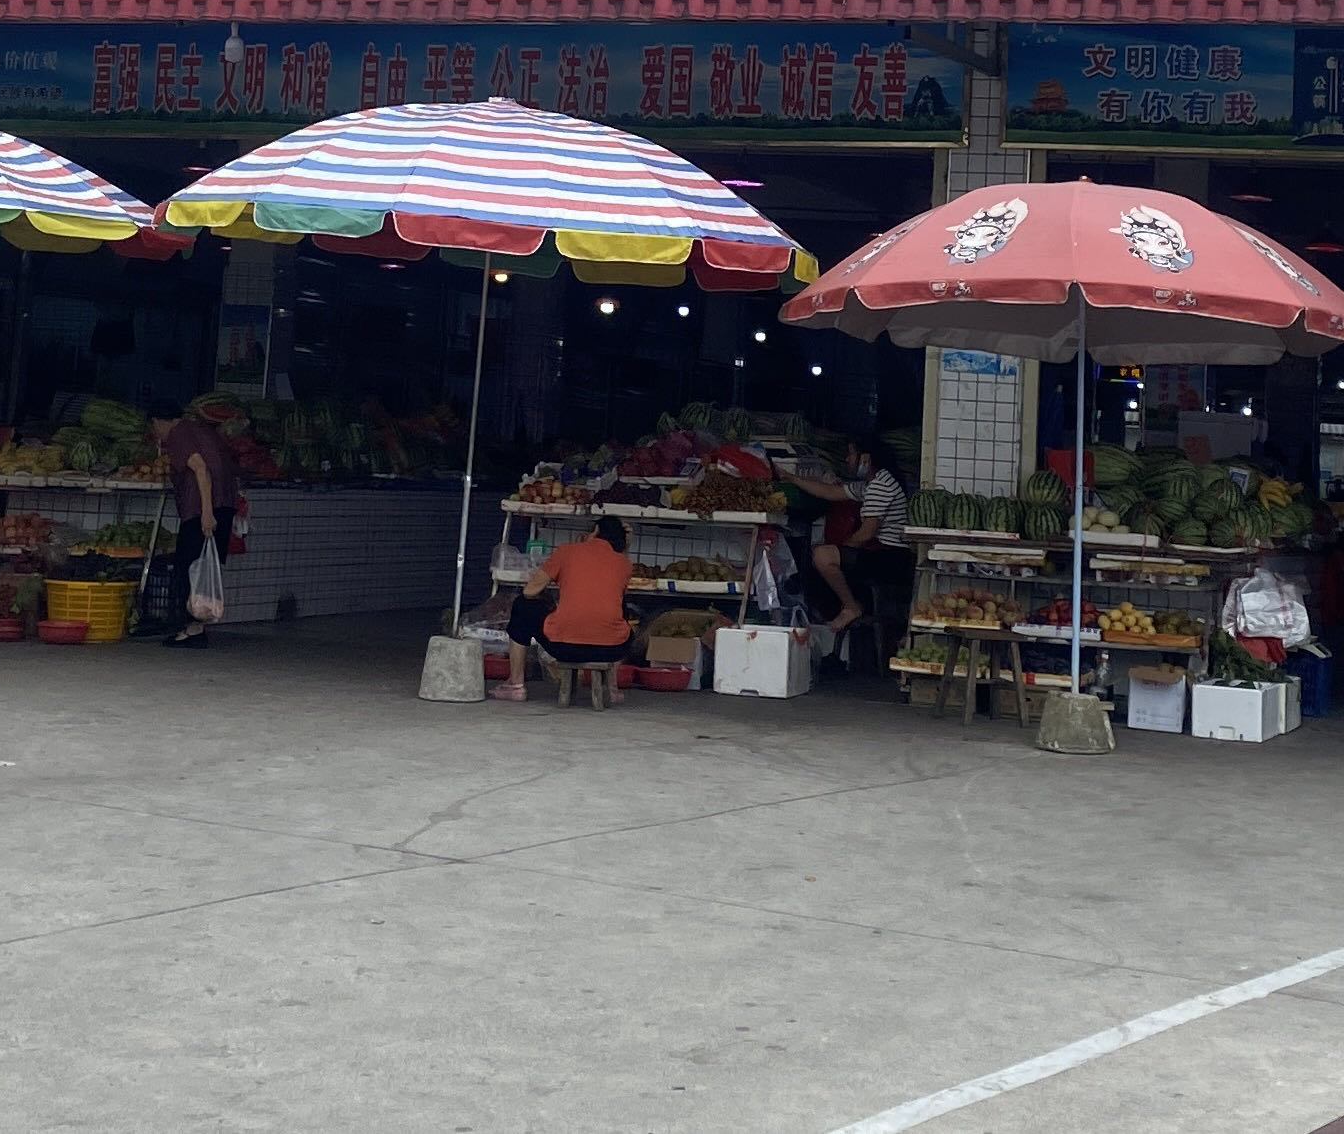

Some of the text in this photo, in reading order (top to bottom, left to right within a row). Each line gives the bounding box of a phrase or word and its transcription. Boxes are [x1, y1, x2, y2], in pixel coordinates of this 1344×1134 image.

[5, 50, 59, 71] 价值观
[1083, 42, 1244, 81] 文明健康
[91, 39, 909, 122] 富强 民主 文明 和谐 自由 平等 公正 法治 爱国 敬业 诚信 友善
[1097, 89, 1259, 126] 有你有我
